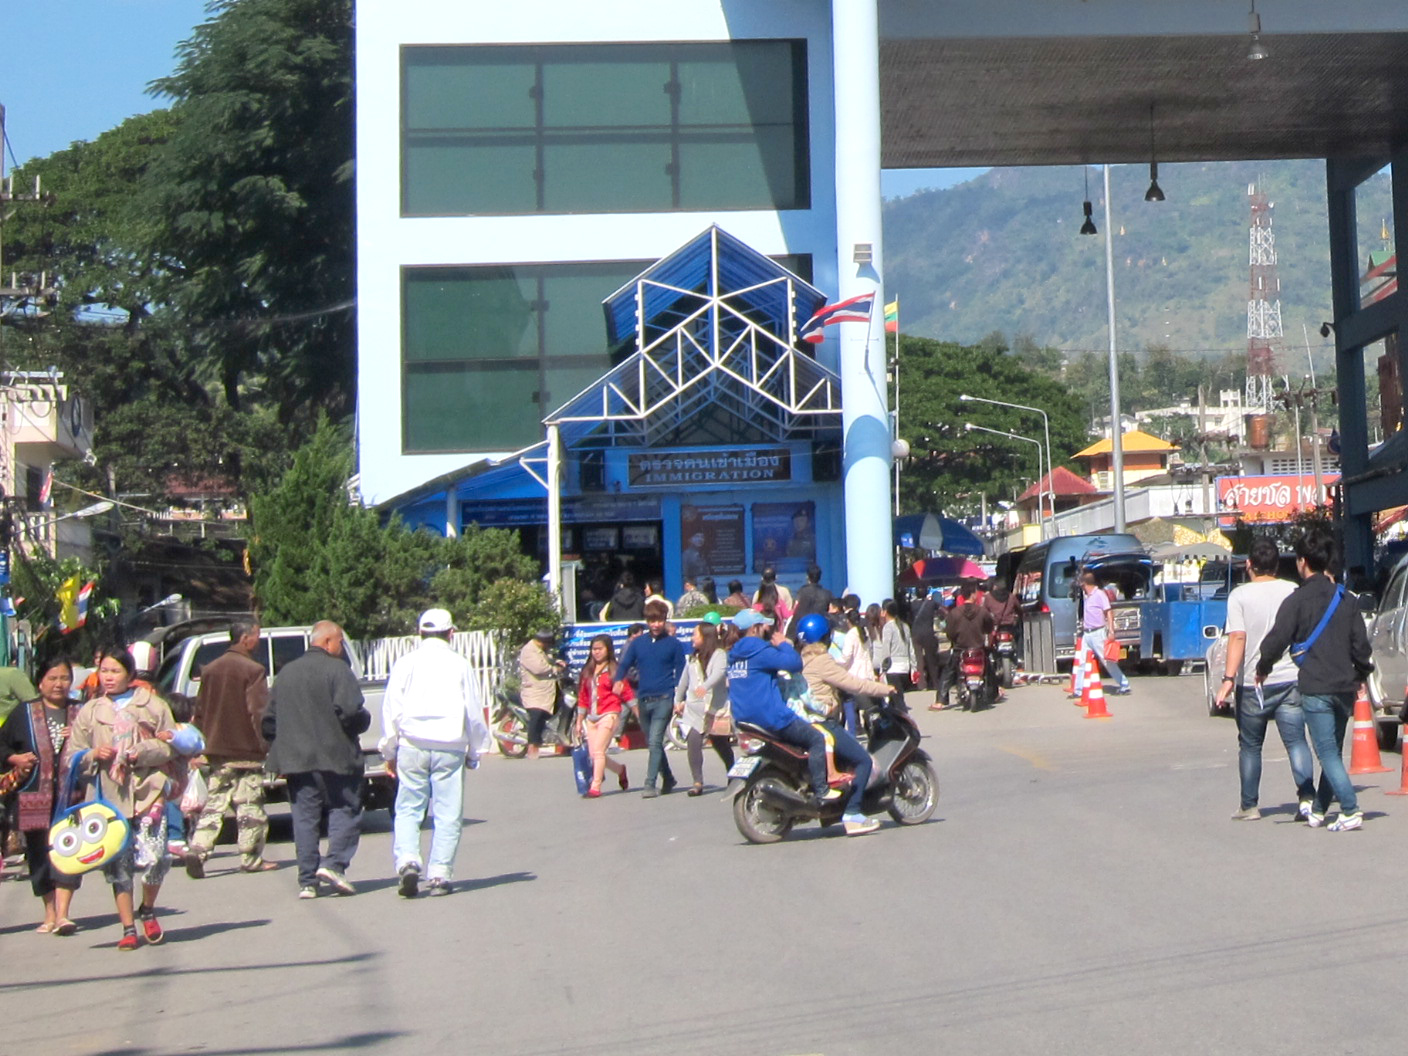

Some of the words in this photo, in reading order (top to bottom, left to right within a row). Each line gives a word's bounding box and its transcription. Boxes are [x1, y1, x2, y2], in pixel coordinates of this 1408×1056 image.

[639, 452, 780, 471] ตรวจคนเข้าเมือง
[645, 469, 774, 483] IMMIGRATION
